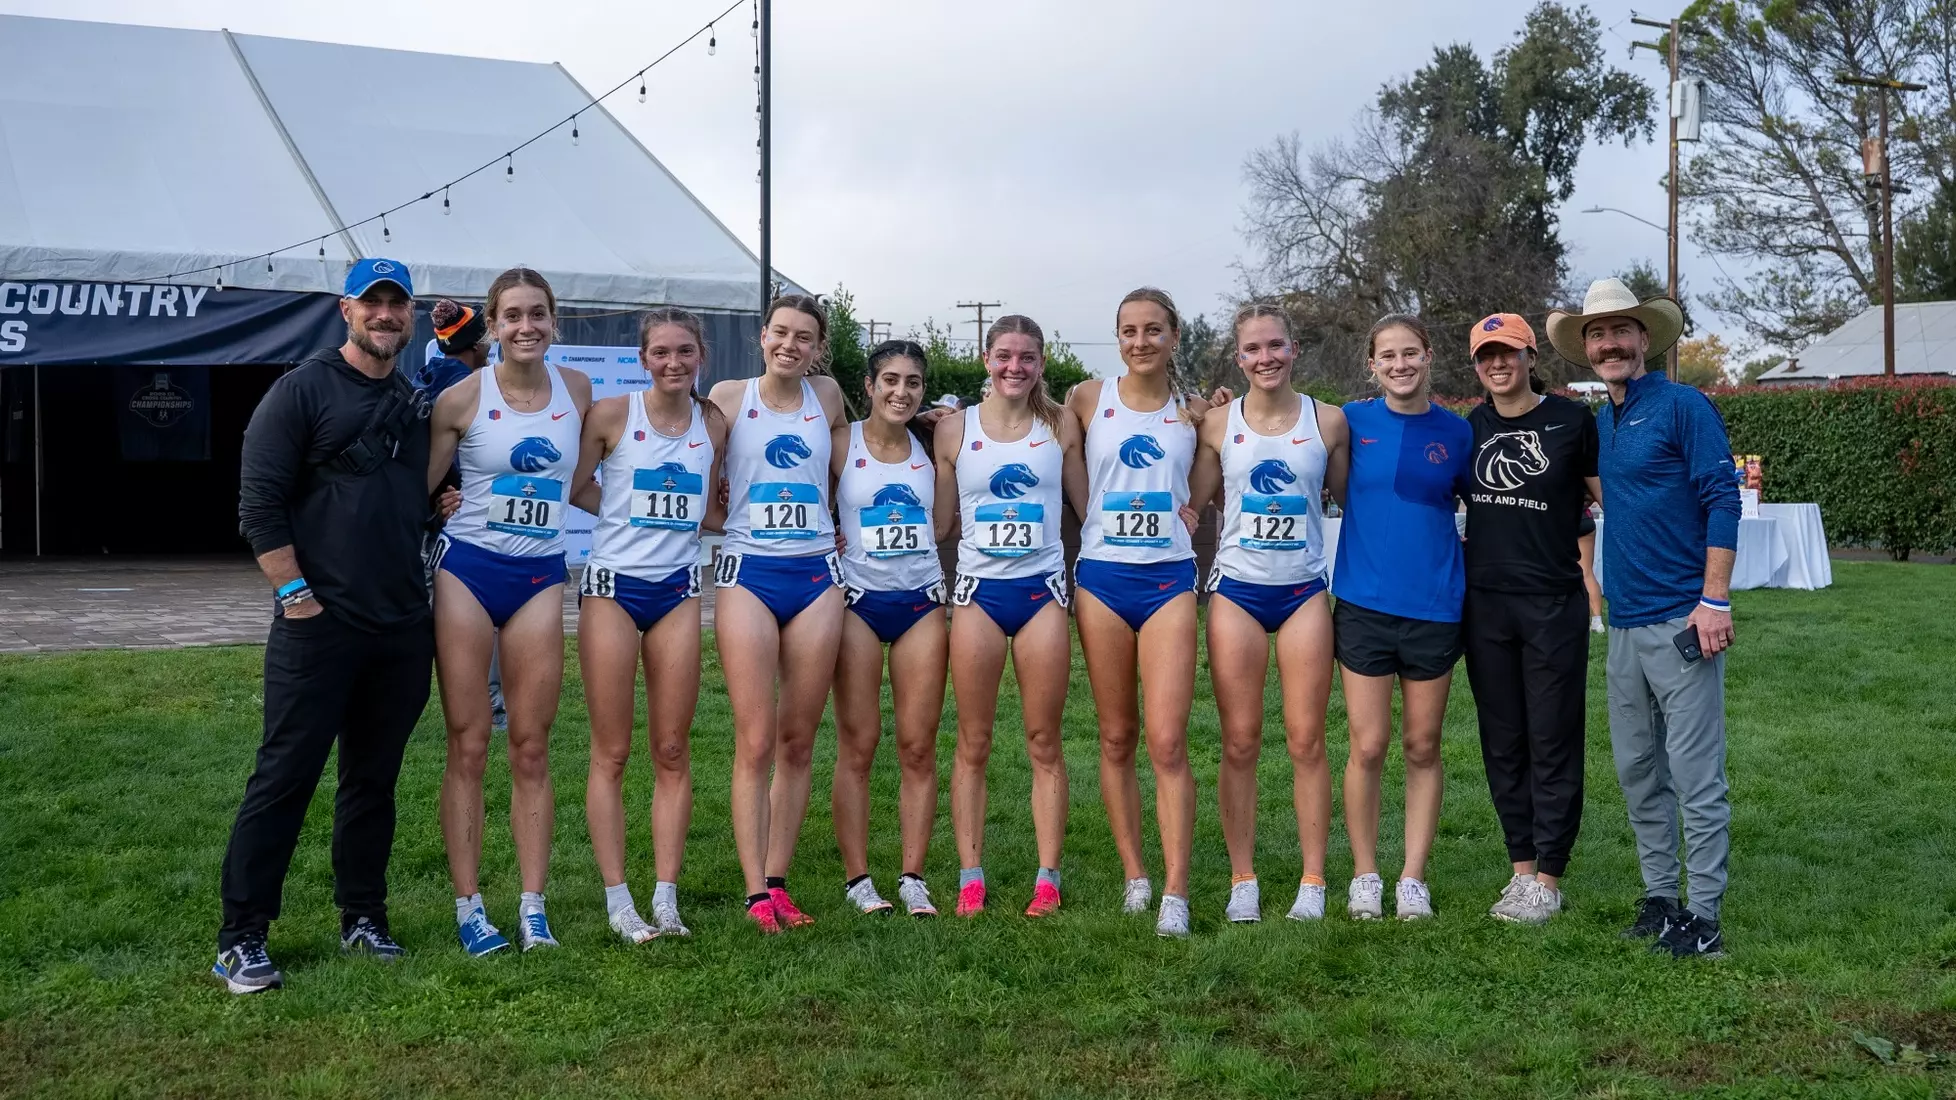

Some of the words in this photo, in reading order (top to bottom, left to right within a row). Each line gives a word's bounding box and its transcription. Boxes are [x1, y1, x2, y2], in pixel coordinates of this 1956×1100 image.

[0, 282, 209, 317] COUNTRY
[131, 401, 192, 409] CHAMPIONSHIPS
[504, 498, 549, 527] 130
[647, 493, 688, 520] 118
[1495, 495, 1516, 506] AND
[1518, 498, 1548, 511] FIELD
[764, 504, 807, 529] 120
[1116, 512, 1159, 537] 128
[1253, 515, 1295, 540] 122
[875, 525, 918, 550] 125
[989, 522, 1032, 547] 123
